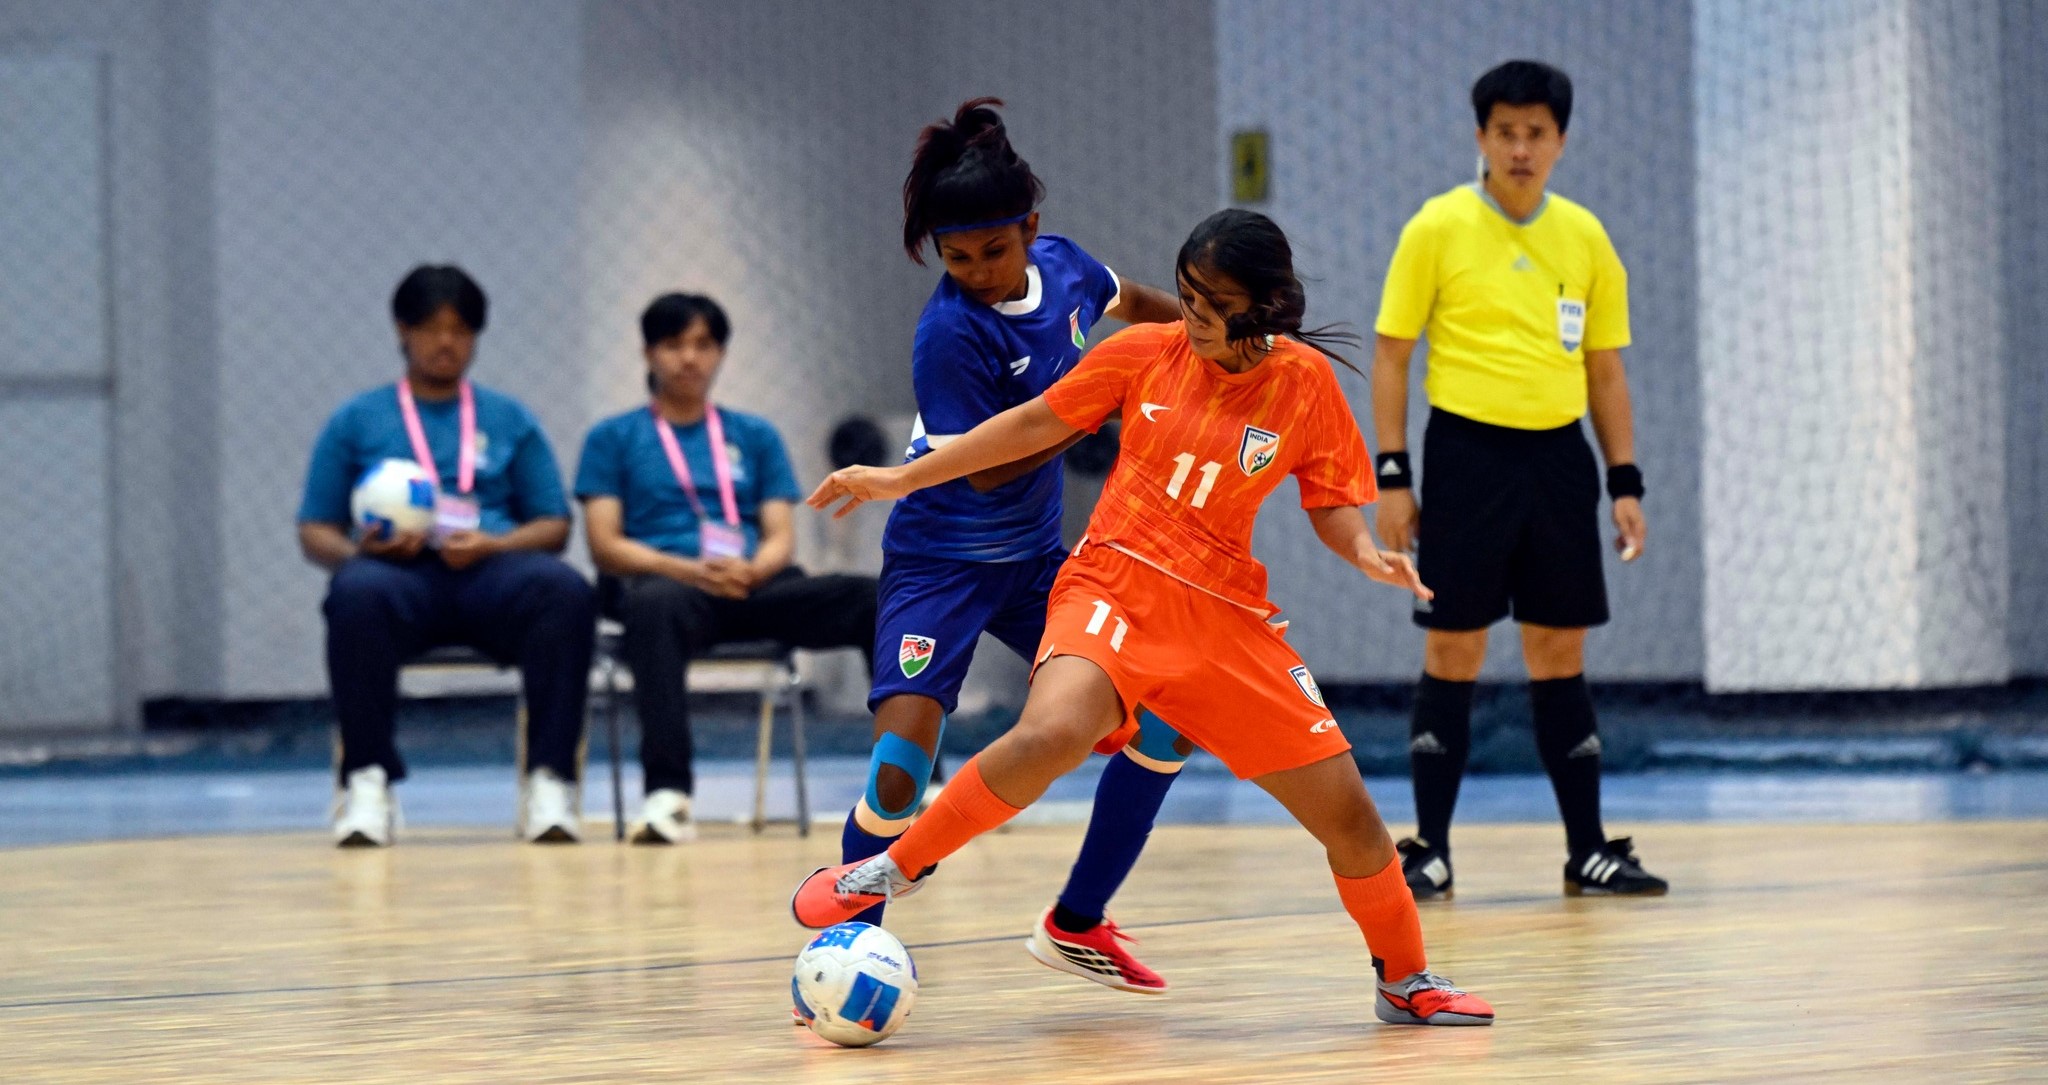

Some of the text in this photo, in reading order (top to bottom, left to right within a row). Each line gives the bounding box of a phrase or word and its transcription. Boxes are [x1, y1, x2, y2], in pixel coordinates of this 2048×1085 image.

[1249, 432, 1268, 443] INDIA
[1165, 451, 1223, 509] 11
[1085, 599, 1129, 654] 11
